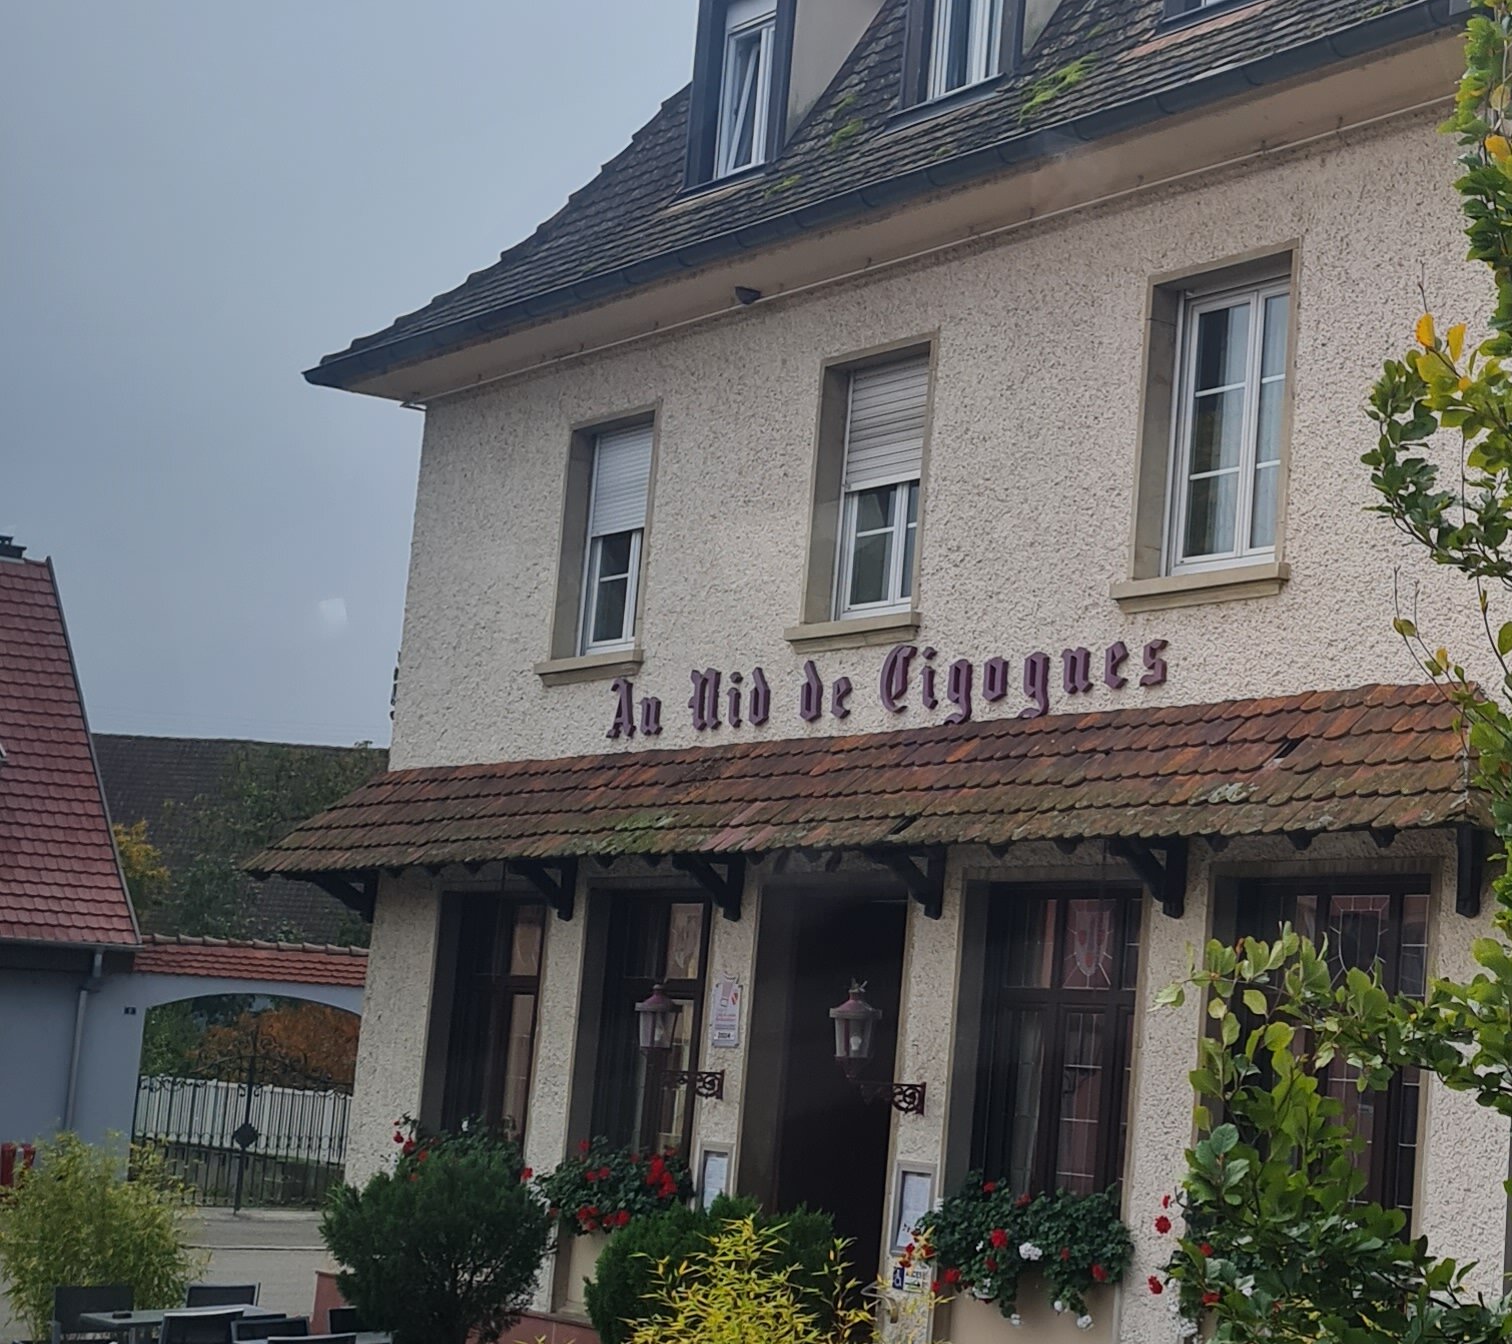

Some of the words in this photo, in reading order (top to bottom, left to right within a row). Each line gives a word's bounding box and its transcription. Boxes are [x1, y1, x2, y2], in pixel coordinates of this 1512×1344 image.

[606, 678, 662, 739] Au
[688, 668, 772, 731] Nid
[800, 660, 853, 722] de
[880, 639, 1170, 725] Cigognes
